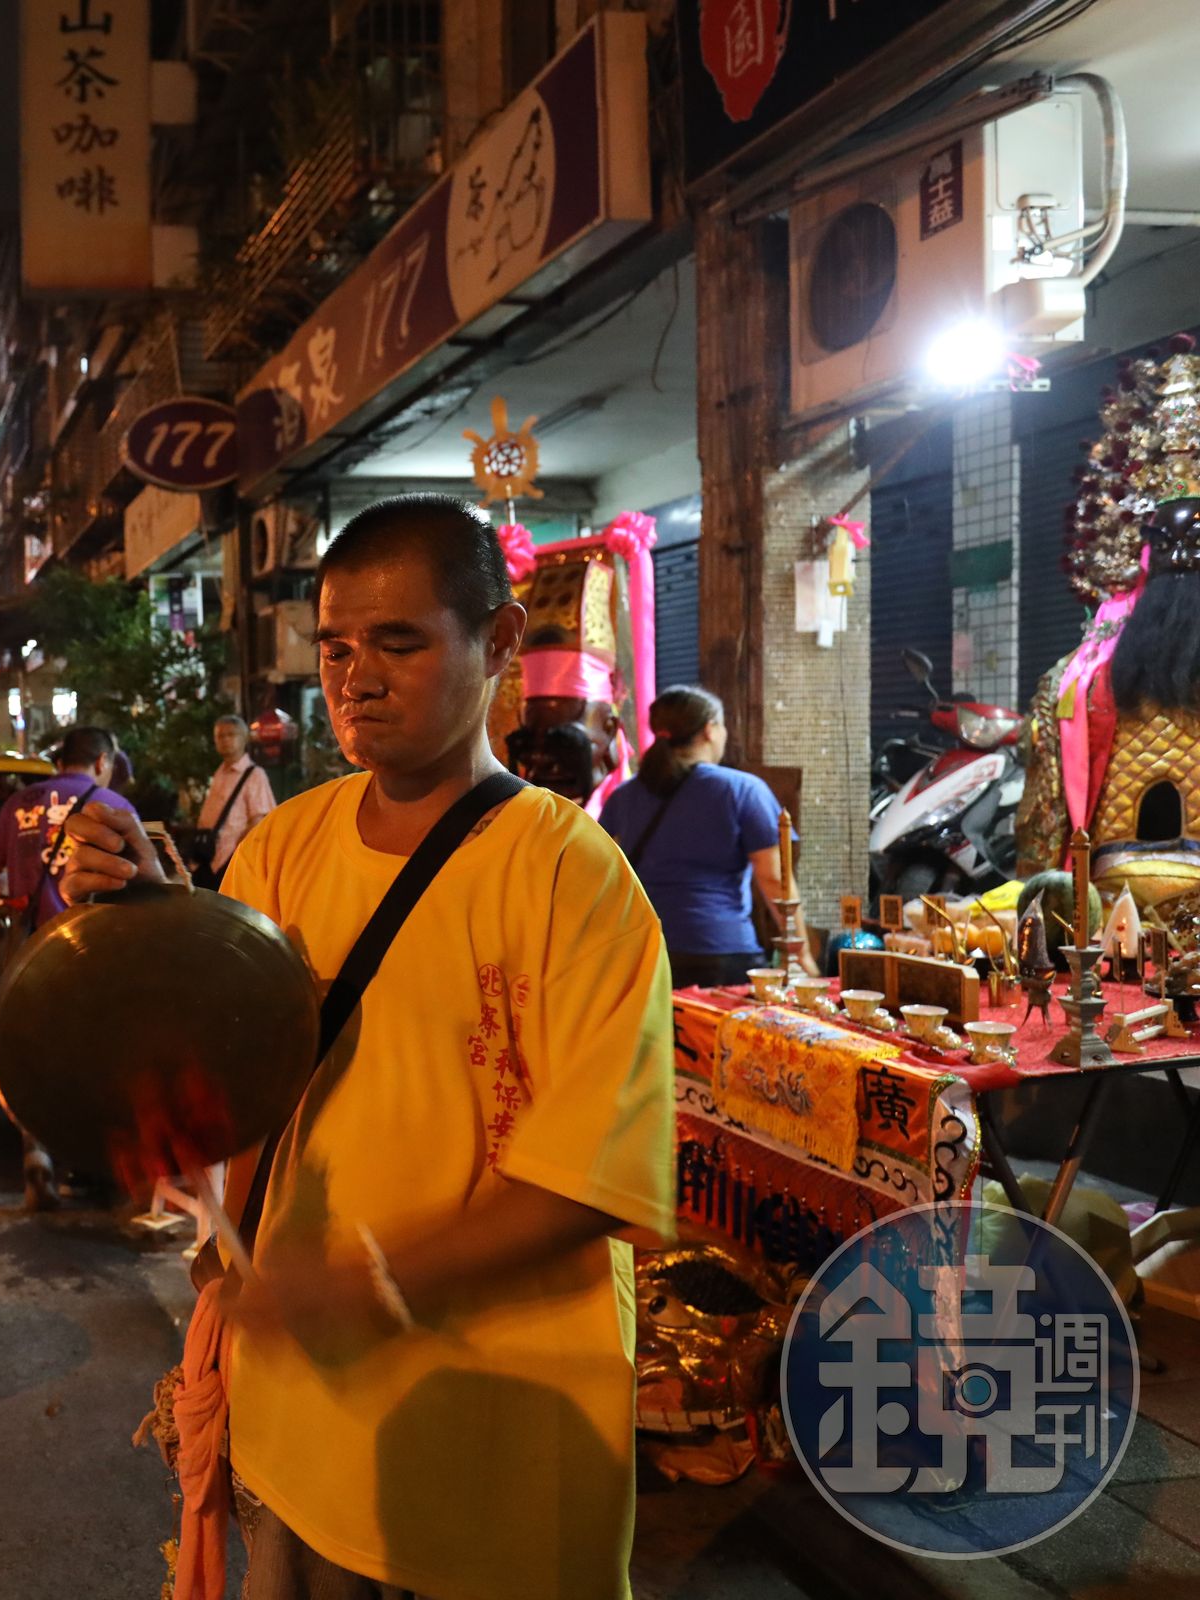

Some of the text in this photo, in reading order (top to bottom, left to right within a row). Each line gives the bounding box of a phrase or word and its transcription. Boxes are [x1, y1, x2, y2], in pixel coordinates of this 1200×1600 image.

[53, 0, 120, 216] 山茶咖啡
[357, 231, 431, 376] 177
[144, 421, 236, 468] 177
